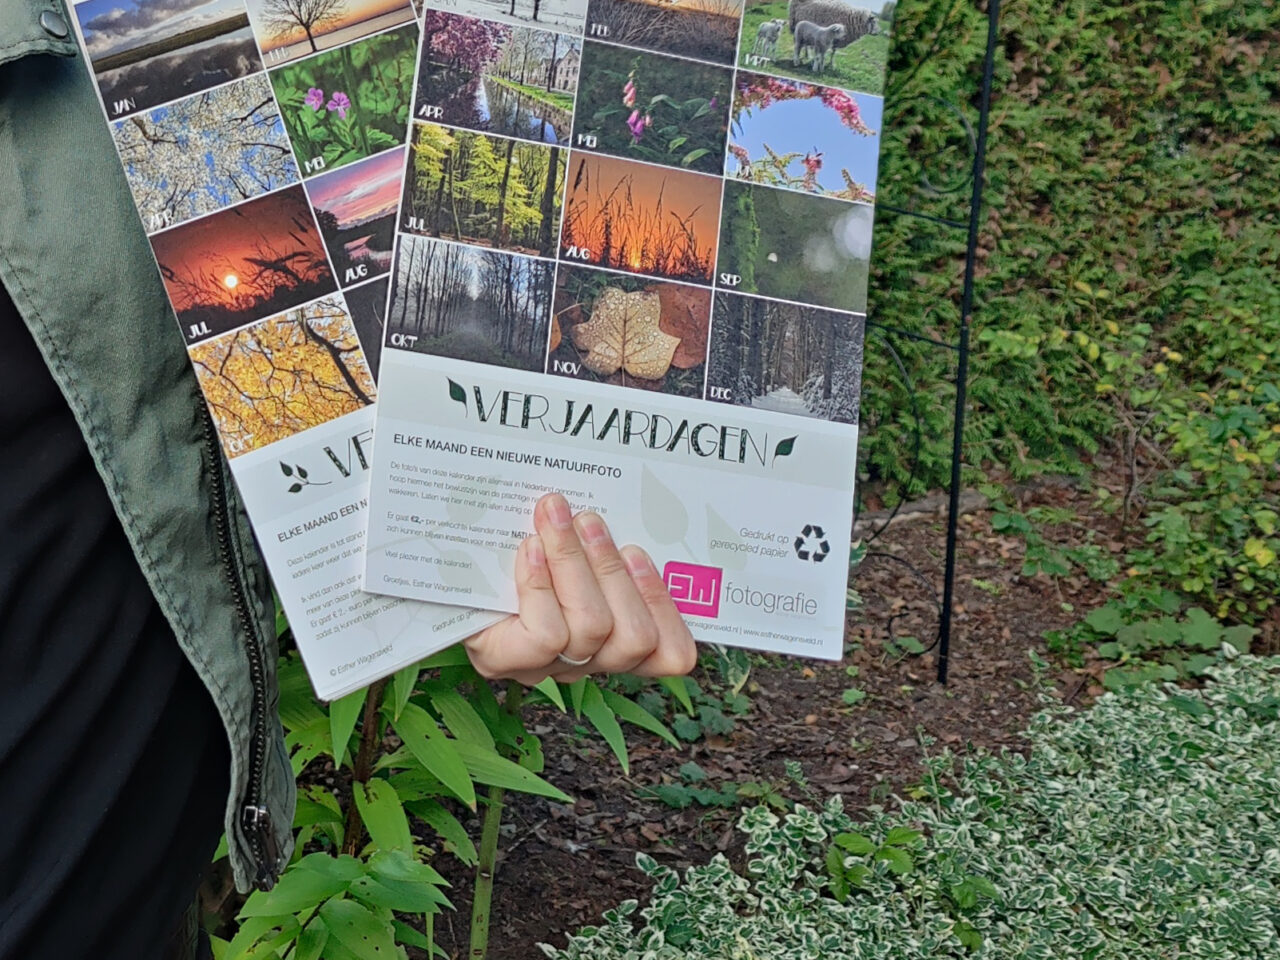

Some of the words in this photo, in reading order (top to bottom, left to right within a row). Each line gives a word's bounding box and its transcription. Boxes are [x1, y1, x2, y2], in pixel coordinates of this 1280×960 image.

[111, 97, 136, 117] JAN
[418, 103, 444, 121] APR
[404, 216, 428, 232] JUL
[565, 246, 591, 262] AUG
[345, 264, 368, 283] AUG
[720, 271, 742, 287] SEP
[189, 321, 212, 339] JUL
[391, 333, 418, 348] OKT
[553, 359, 582, 377] NOV
[710, 385, 733, 402] DEC
[473, 385, 768, 466] VERJAARDAGEN
[393, 433, 423, 449] ELKE
[425, 438, 468, 455] MAAND
[470, 445, 494, 460] EEN
[496, 449, 542, 467] NIEUWE
[544, 456, 622, 479] NATUURFOTO
[277, 525, 303, 542] ELKE
[303, 512, 339, 532] MAAND
[340, 502, 360, 517] EEN
[739, 527, 776, 542] Gedrukt
[777, 533, 790, 545] op
[710, 539, 759, 555] gerecycled
[759, 545, 789, 559] papier
[725, 581, 818, 615] fotografie
